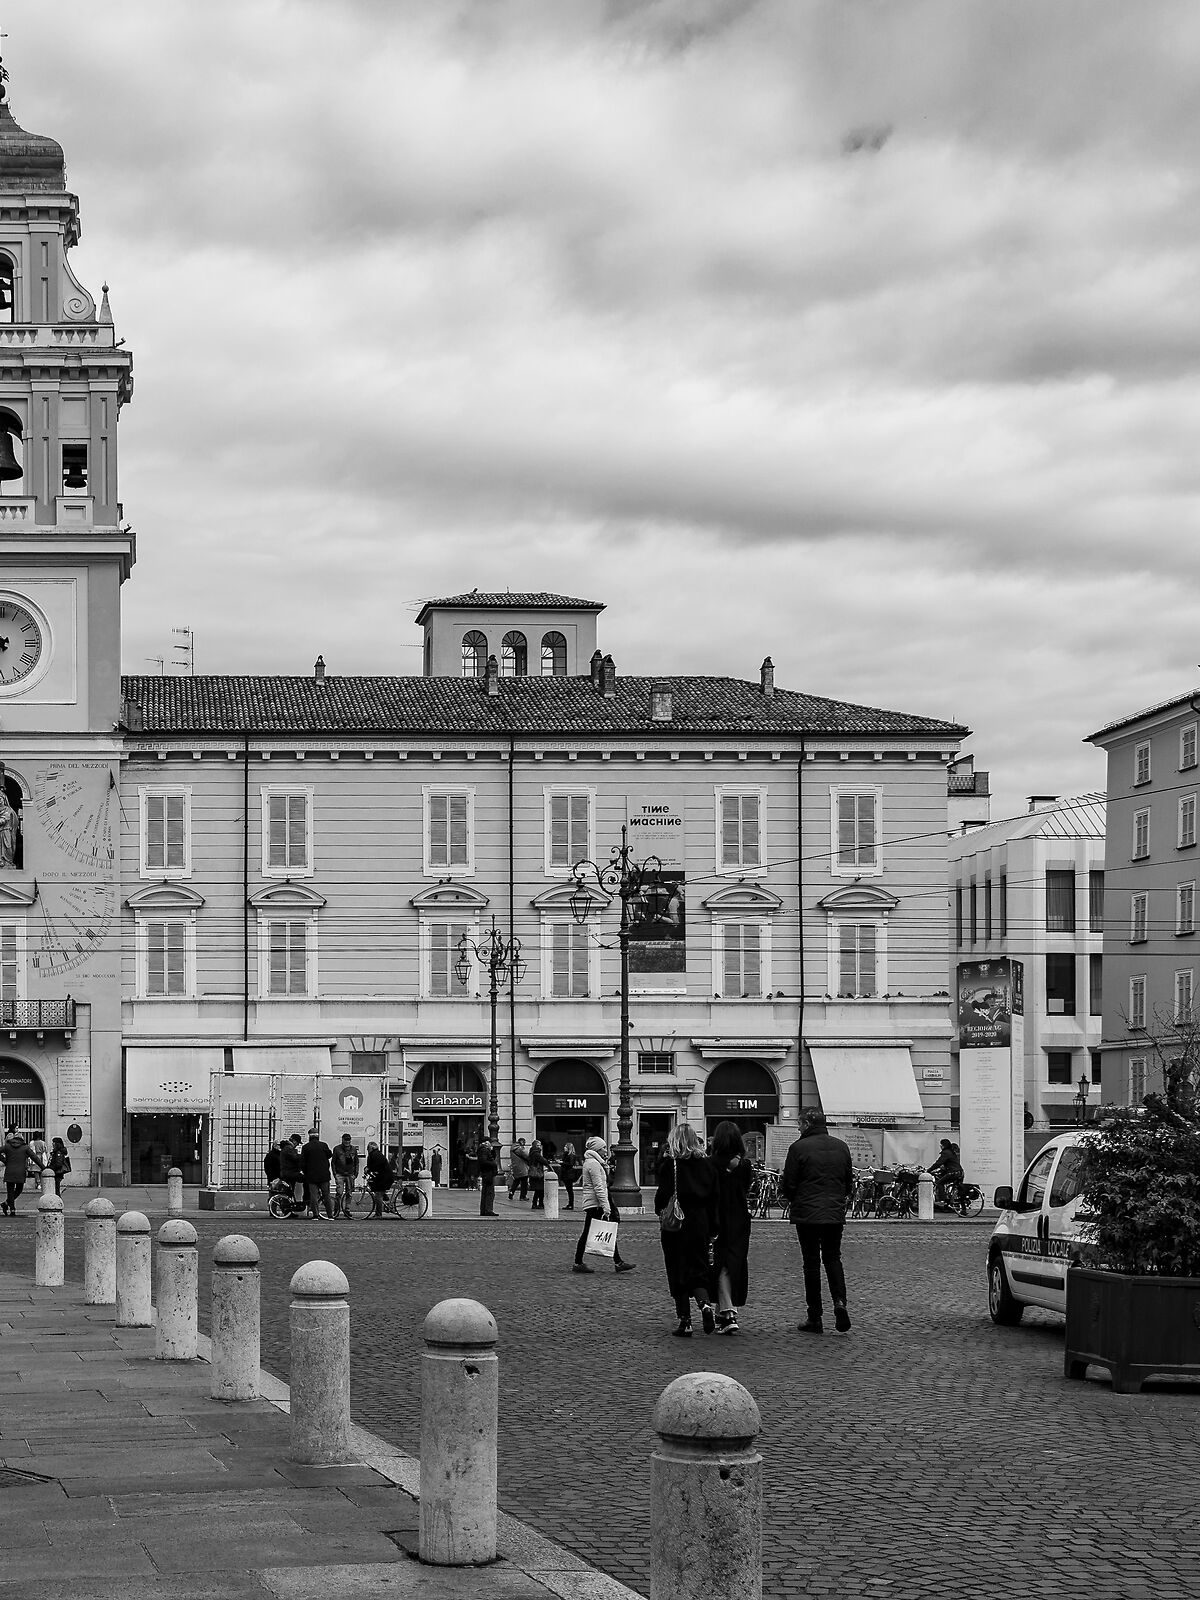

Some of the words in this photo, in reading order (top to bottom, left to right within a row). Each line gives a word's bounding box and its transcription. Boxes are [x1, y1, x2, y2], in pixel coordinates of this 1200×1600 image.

[20, 623, 31, 632] II
[25, 639, 36, 647] III
[416, 1094, 482, 1105] sarabanda
[567, 1099, 587, 1108] TIM
[737, 1100, 758, 1109] TIM
[594, 1231, 613, 1243] H&M
[1022, 1238, 1041, 1254] POLIZIA
[1048, 1241, 1070, 1258] LOCALE
